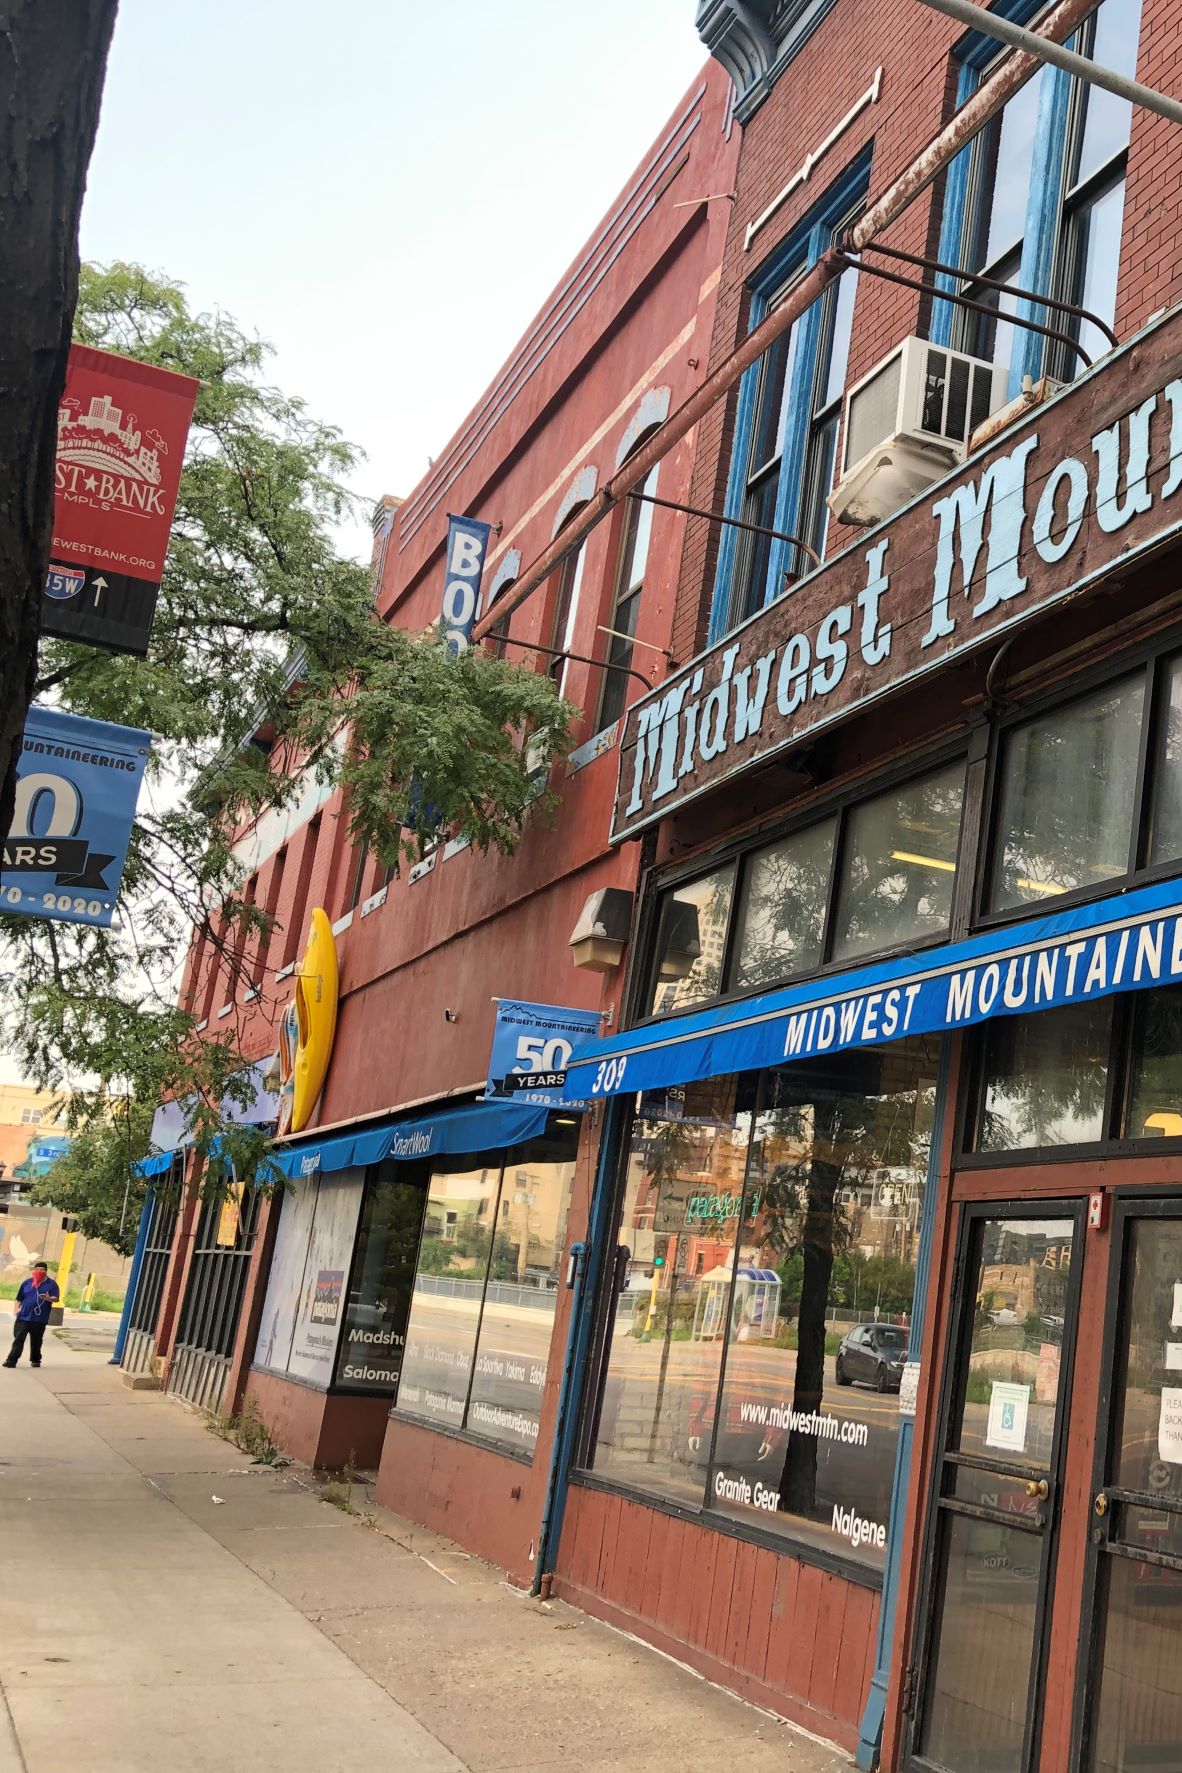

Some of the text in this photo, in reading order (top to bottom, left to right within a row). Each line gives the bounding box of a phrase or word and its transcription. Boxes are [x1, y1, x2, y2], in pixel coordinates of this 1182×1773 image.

[63, 493, 112, 512] MPLS
[97, 474, 167, 516] BANK
[51, 537, 157, 570] EWESTBANK.ORG
[626, 538, 893, 818] Midwest
[9, 772, 83, 838] 0
[43, 892, 102, 917] 2020
[501, 1016, 596, 1035] MIDWEST MOUNTAINEERING
[783, 983, 922, 1058] MIDWEST
[512, 1036, 573, 1074] 50
[517, 1073, 565, 1088] YEARS
[592, 1056, 627, 1093] 309
[525, 1093, 551, 1104] 1970
[390, 1127, 434, 1156] SmartWool
[505, 1361, 526, 1382] Yakima
[740, 1402, 869, 1446] www.midwestmtn.com
[1164, 1414, 1182, 1426] BACK
[715, 1471, 781, 1513] Granite Gear
[831, 1504, 886, 1548] Nalgene
